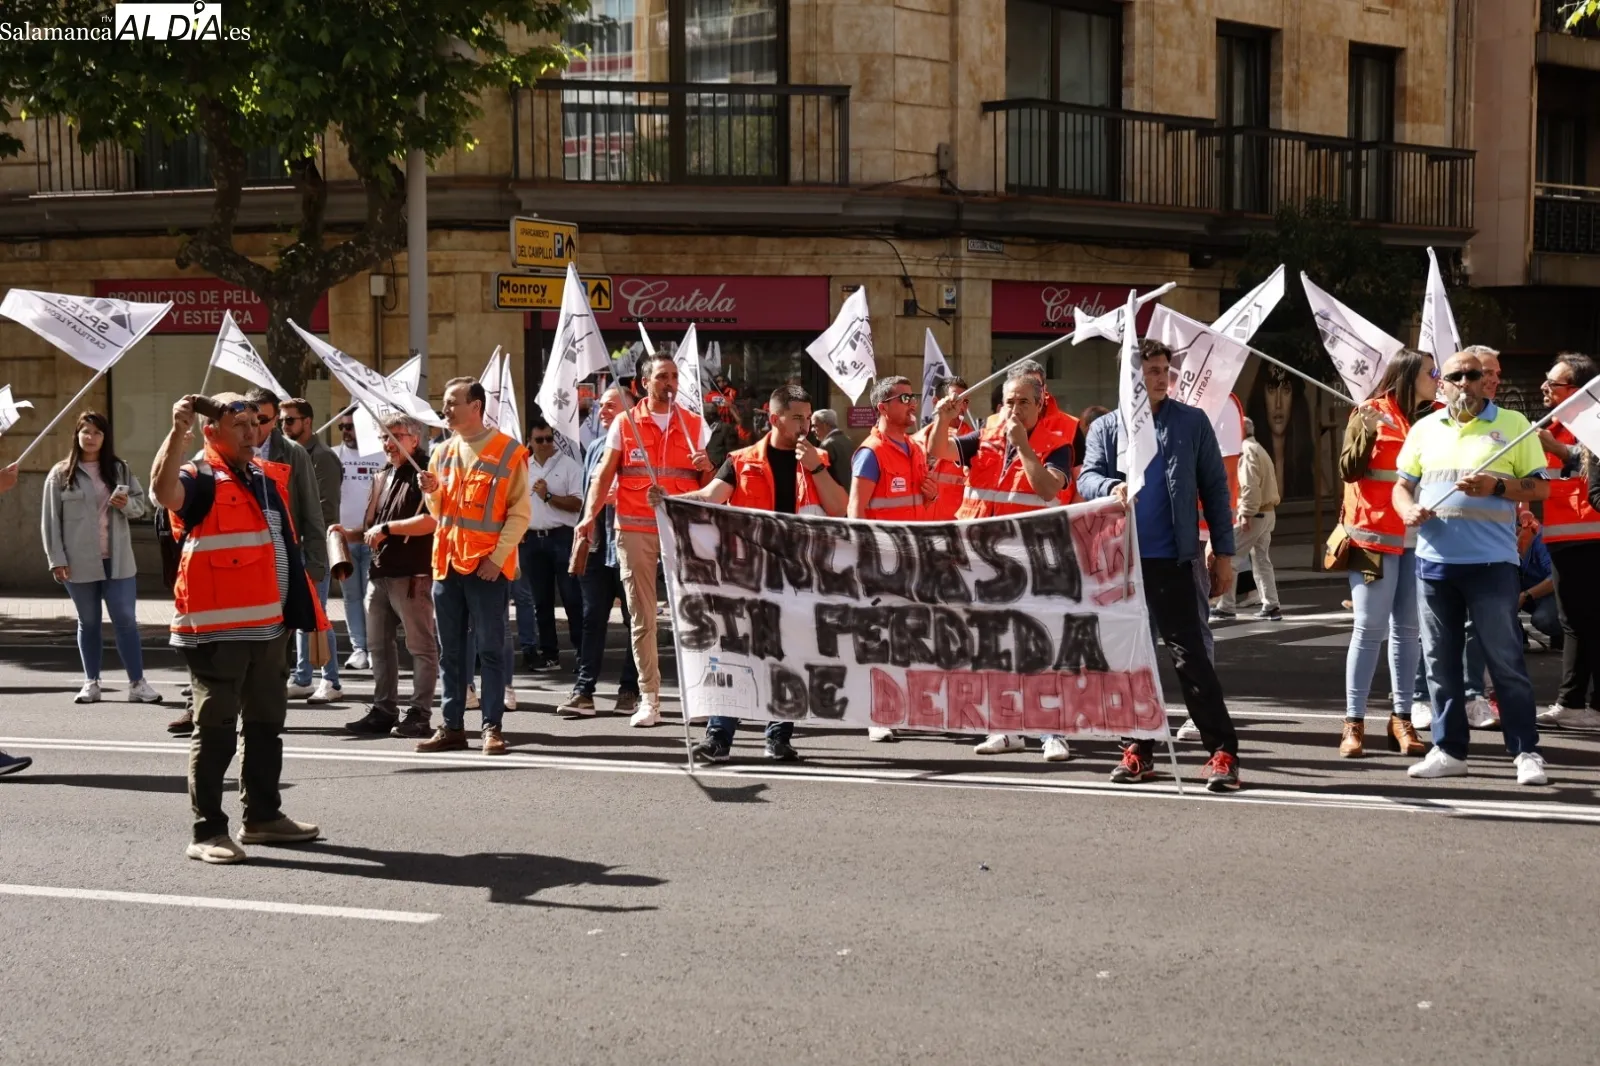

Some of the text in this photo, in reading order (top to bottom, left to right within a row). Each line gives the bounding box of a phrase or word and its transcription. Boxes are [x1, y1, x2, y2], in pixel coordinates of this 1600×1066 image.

[200, 290, 219, 304] DE
[500, 279, 547, 297] Monroy
[619, 278, 736, 317] Castela
[170, 310, 180, 324] Y
[668, 499, 1083, 604] CONCURSO
[678, 593, 784, 661] SIN
[766, 662, 1166, 735] DE DERECHOS
